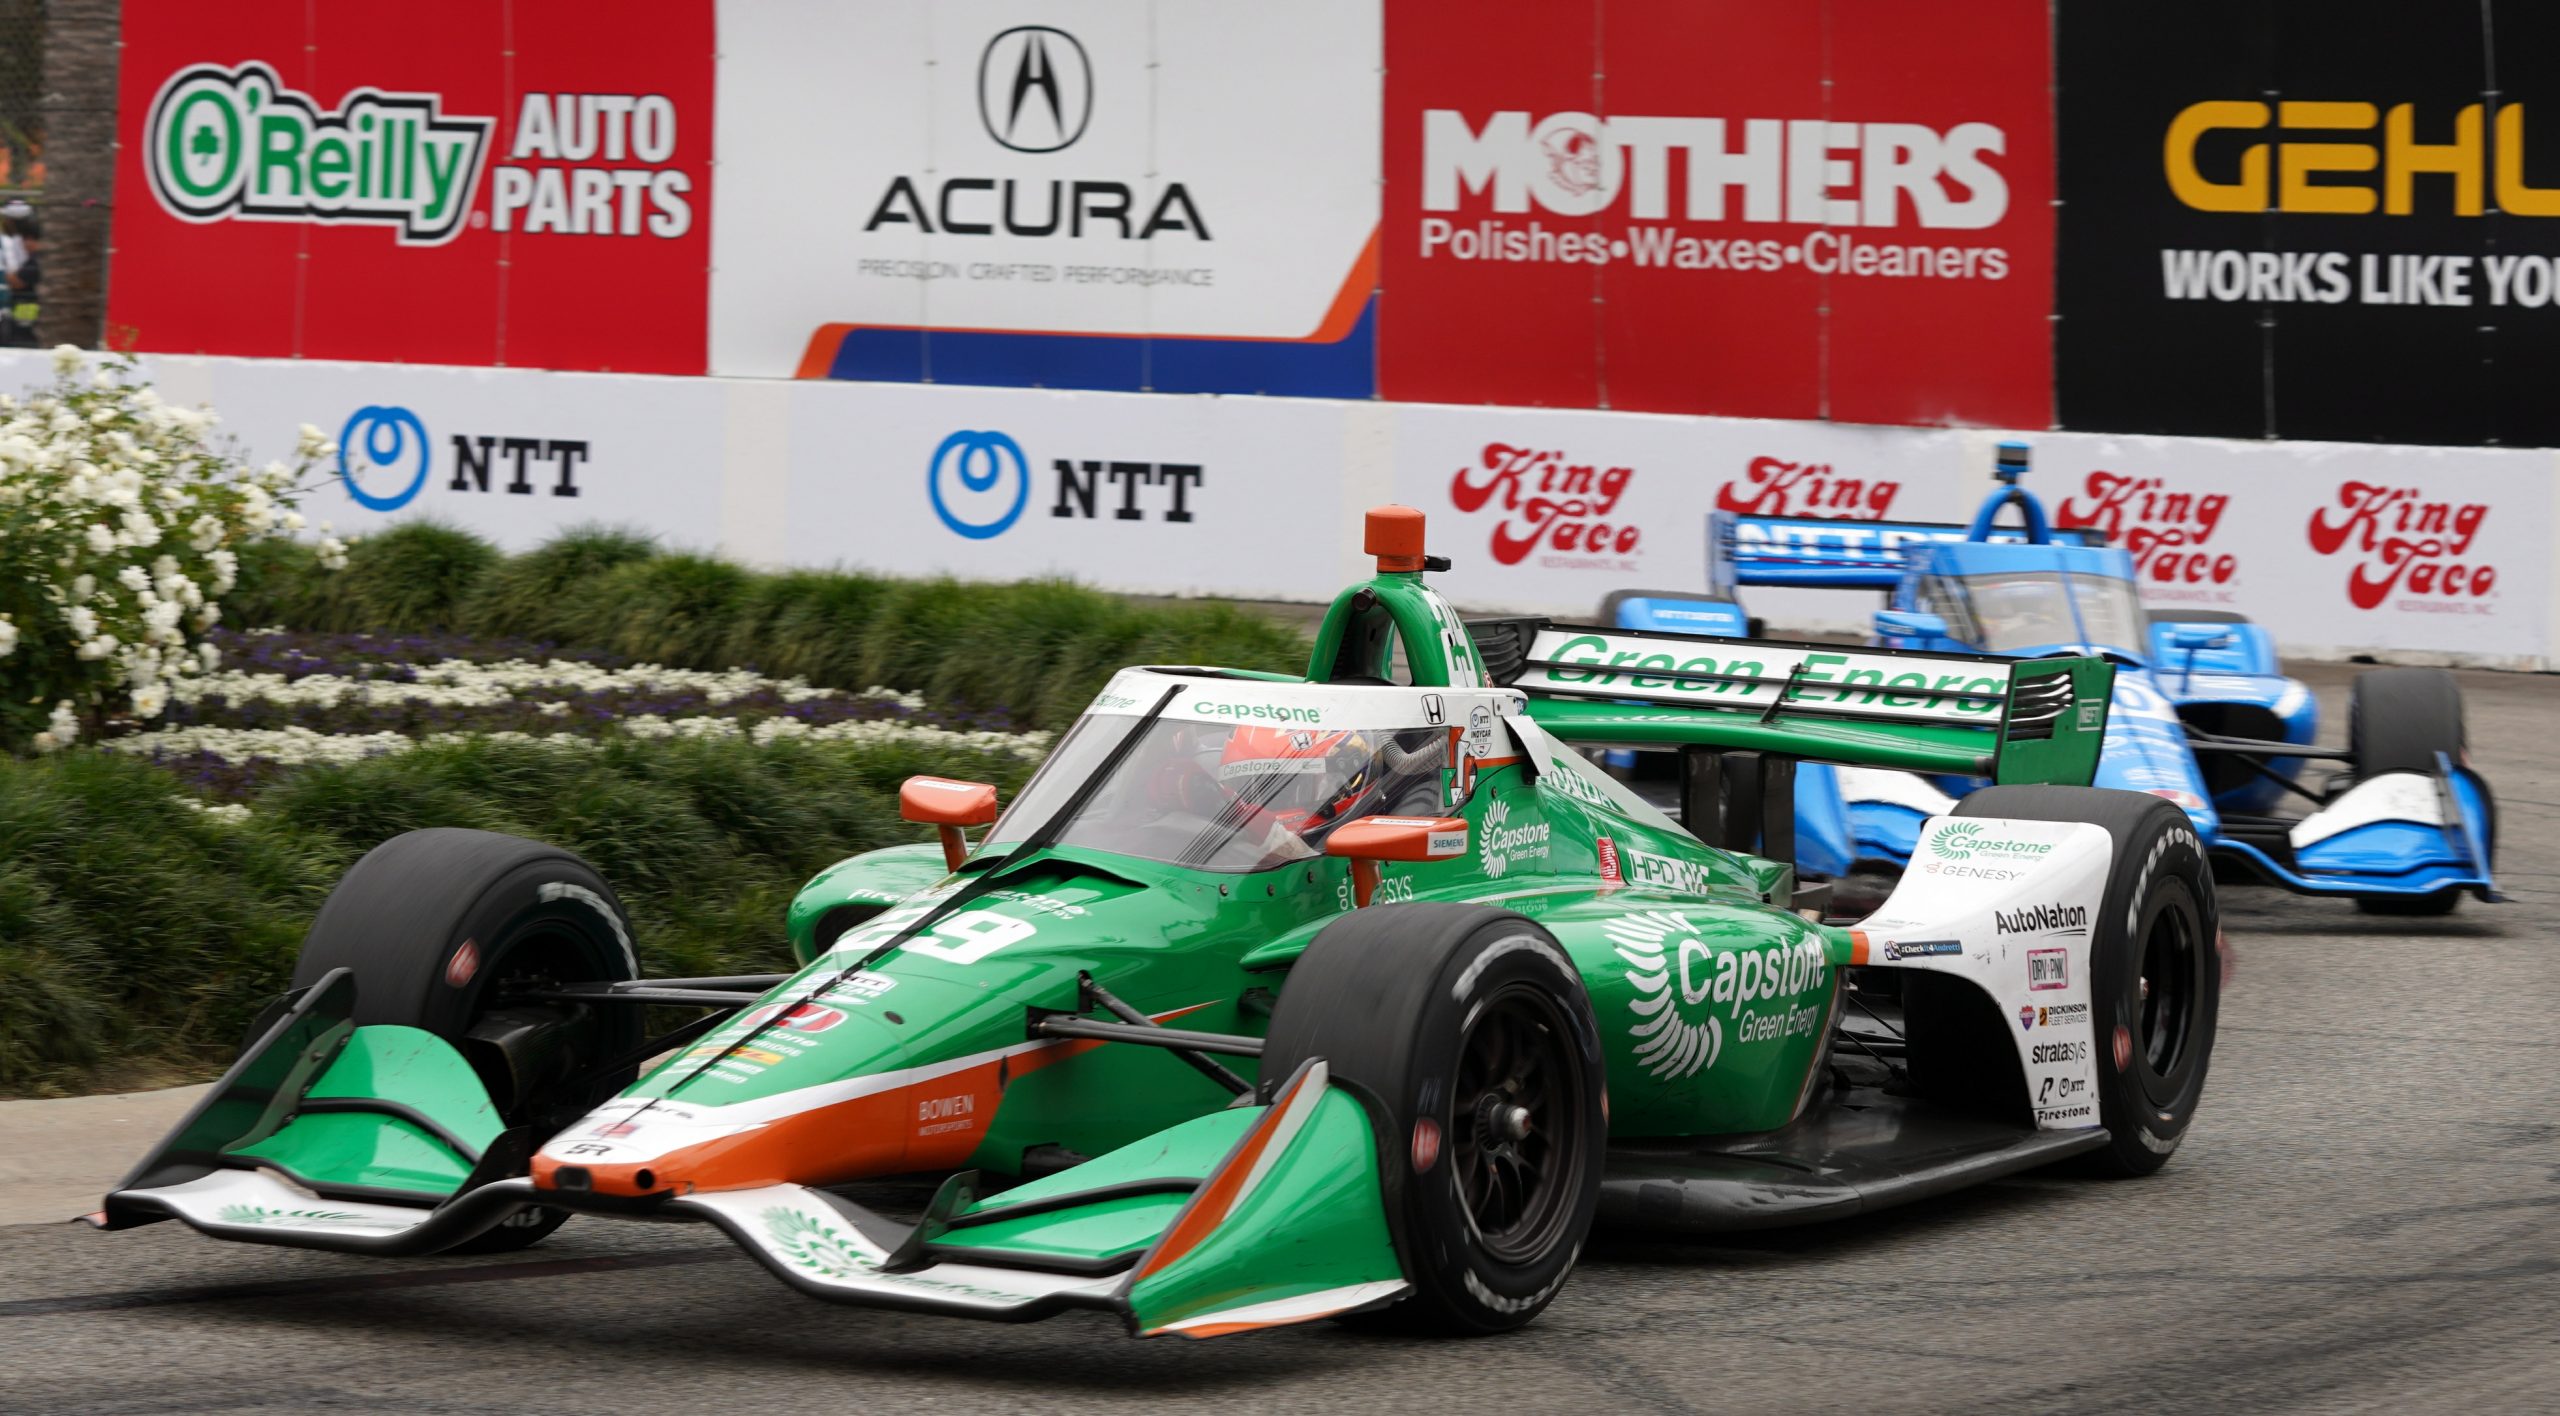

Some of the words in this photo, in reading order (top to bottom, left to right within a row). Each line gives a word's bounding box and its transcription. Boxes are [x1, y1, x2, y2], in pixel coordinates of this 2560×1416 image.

[511, 92, 677, 163] AUTO
[167, 85, 464, 221] O'Reilly
[1421, 108, 2010, 230] MOTHERS
[491, 166, 692, 239] PARTS
[861, 175, 1214, 241] ACURA
[857, 258, 960, 280] PRECISION
[967, 262, 1058, 283] CRAFTED
[1063, 266, 1214, 287] PERFORMANCE
[2161, 248, 2351, 304] WORKS
[2360, 253, 2473, 306] LIKE
[2481, 254, 2560, 308] YO
[449, 433, 588, 498] NTT
[1451, 442, 1635, 516] King
[1716, 455, 1902, 519] King
[1049, 458, 1205, 523] NTT
[2056, 470, 2230, 544] King
[1490, 496, 1641, 566] Taco
[1734, 523, 1877, 558] NTT
[2308, 480, 2490, 556] King
[2348, 537, 2497, 610] Taco
[1546, 634, 1765, 696] Green
[1787, 652, 2009, 717] Energ
[1193, 700, 1321, 724] Capstone
[1471, 729, 1492, 739] INDYCAR
[1223, 760, 1281, 777] Capstone
[1433, 837, 1464, 849] SIEMENS
[1491, 822, 1550, 854] Capstone
[1509, 849, 1529, 862] Green
[1528, 845, 1550, 861] Energy
[1950, 835, 2052, 854] Capstone
[1629, 852, 1675, 884] HPD
[829, 906, 1038, 965] 29
[1995, 902, 2087, 935] AutoNation
[1679, 931, 1826, 1019] Capstone
[1738, 1008, 1785, 1043] Green
[1785, 1003, 1820, 1038] Energy
[2048, 1003, 2088, 1016] DICKINSON
[2032, 1040, 2087, 1064] stratasys
[919, 1093, 975, 1121] BOWEN
[2070, 1079, 2085, 1093] NTT
[2036, 1105, 2091, 1123] Firestone
